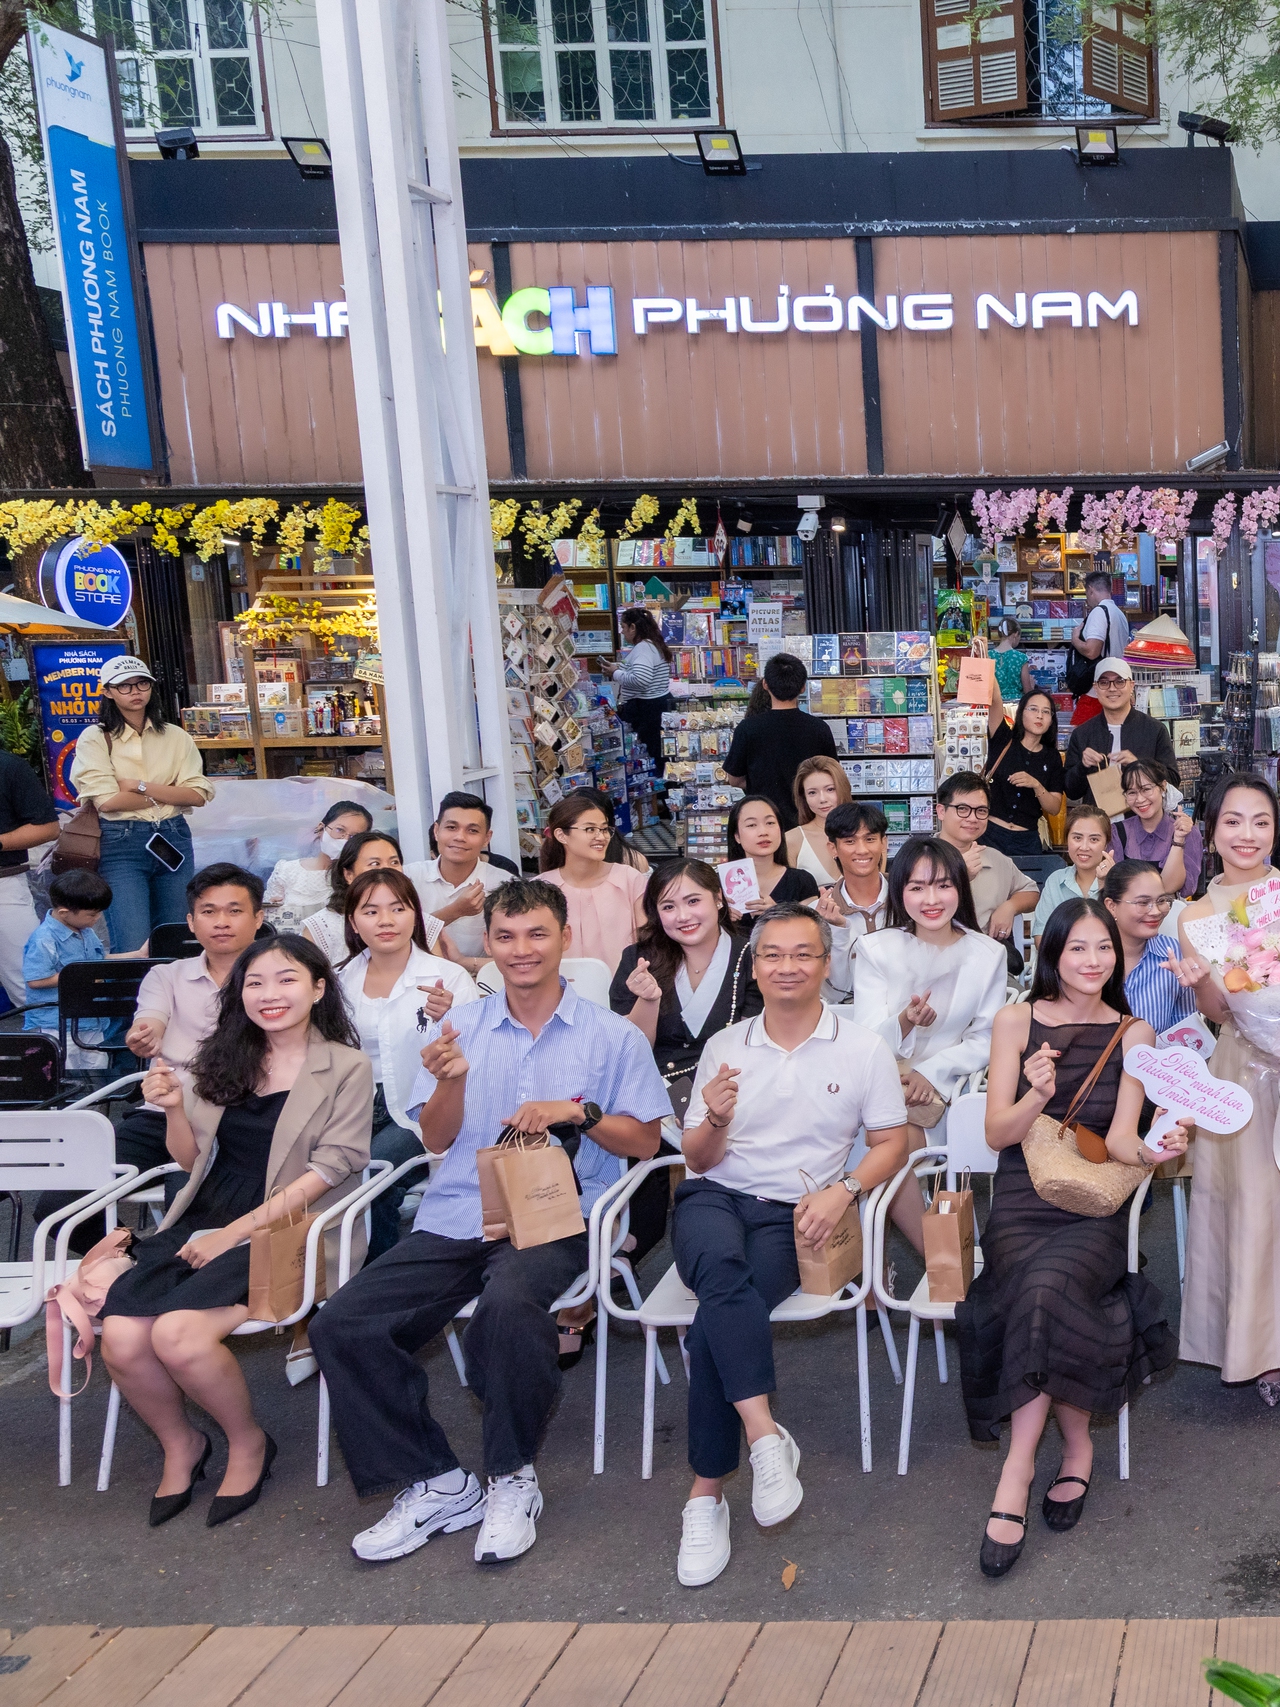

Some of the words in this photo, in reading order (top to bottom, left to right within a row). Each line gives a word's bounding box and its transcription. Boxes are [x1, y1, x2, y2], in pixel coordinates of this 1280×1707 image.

[45, 76, 92, 102] phuongnam
[70, 168, 95, 235] NAM
[96, 200, 113, 262] BOOK
[79, 241, 107, 355] PHƯƠNG
[105, 271, 121, 319] NAM
[631, 284, 955, 335] PHƯƠNG
[976, 288, 1140, 331] NAM
[111, 328, 133, 418] PHUONG
[93, 361, 117, 438] SÁCH
[74, 571, 121, 594] BOOK
[105, 567, 121, 575] NAM
[74, 590, 122, 605] STORE
[751, 617, 780, 625] ATLAS
[79, 649, 97, 657] SÁCH
[43, 667, 85, 684] MEMBER
[1250, 886, 1267, 902] Chúc
[1136, 1050, 1190, 1095] Thương
[1160, 1052, 1199, 1080] Hiểu
[1189, 1080, 1225, 1099] mình
[1219, 1091, 1245, 1113] hơn,
[1165, 1090, 1207, 1110] mình
[1195, 1104, 1231, 1126] nhiều
